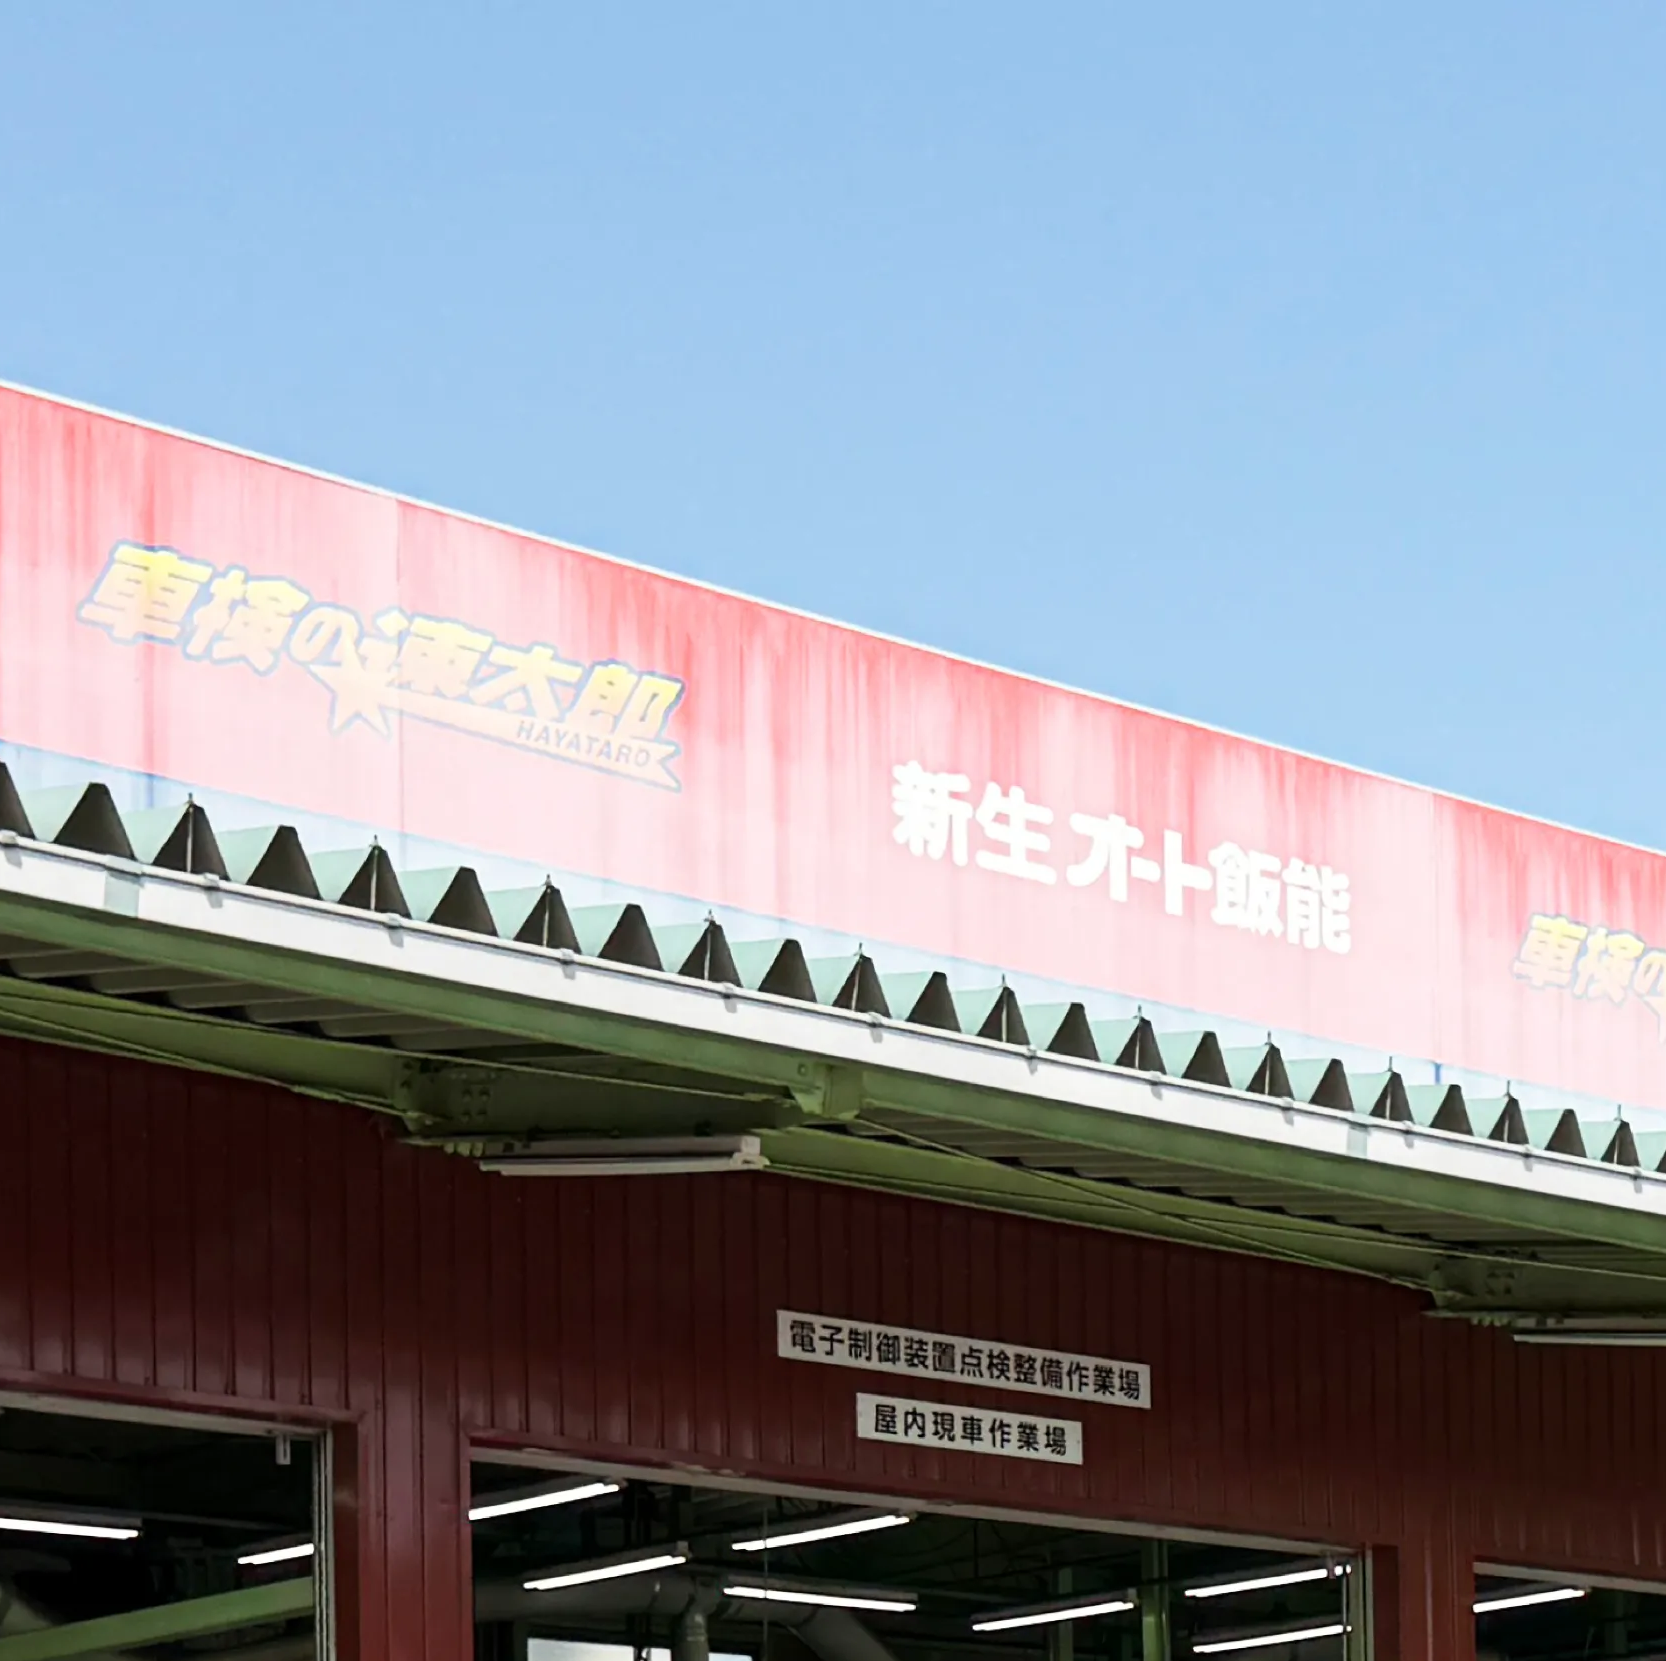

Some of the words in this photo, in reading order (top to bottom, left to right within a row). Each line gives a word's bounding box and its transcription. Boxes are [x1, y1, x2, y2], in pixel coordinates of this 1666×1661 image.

[77, 540, 684, 740] 車検の速太郎
[516, 719, 652, 769] HAYATARO
[790, 1320, 1140, 1400] 電子制御装置点検整備作業場
[875, 1404, 1067, 1456] 屋内現車作業場
